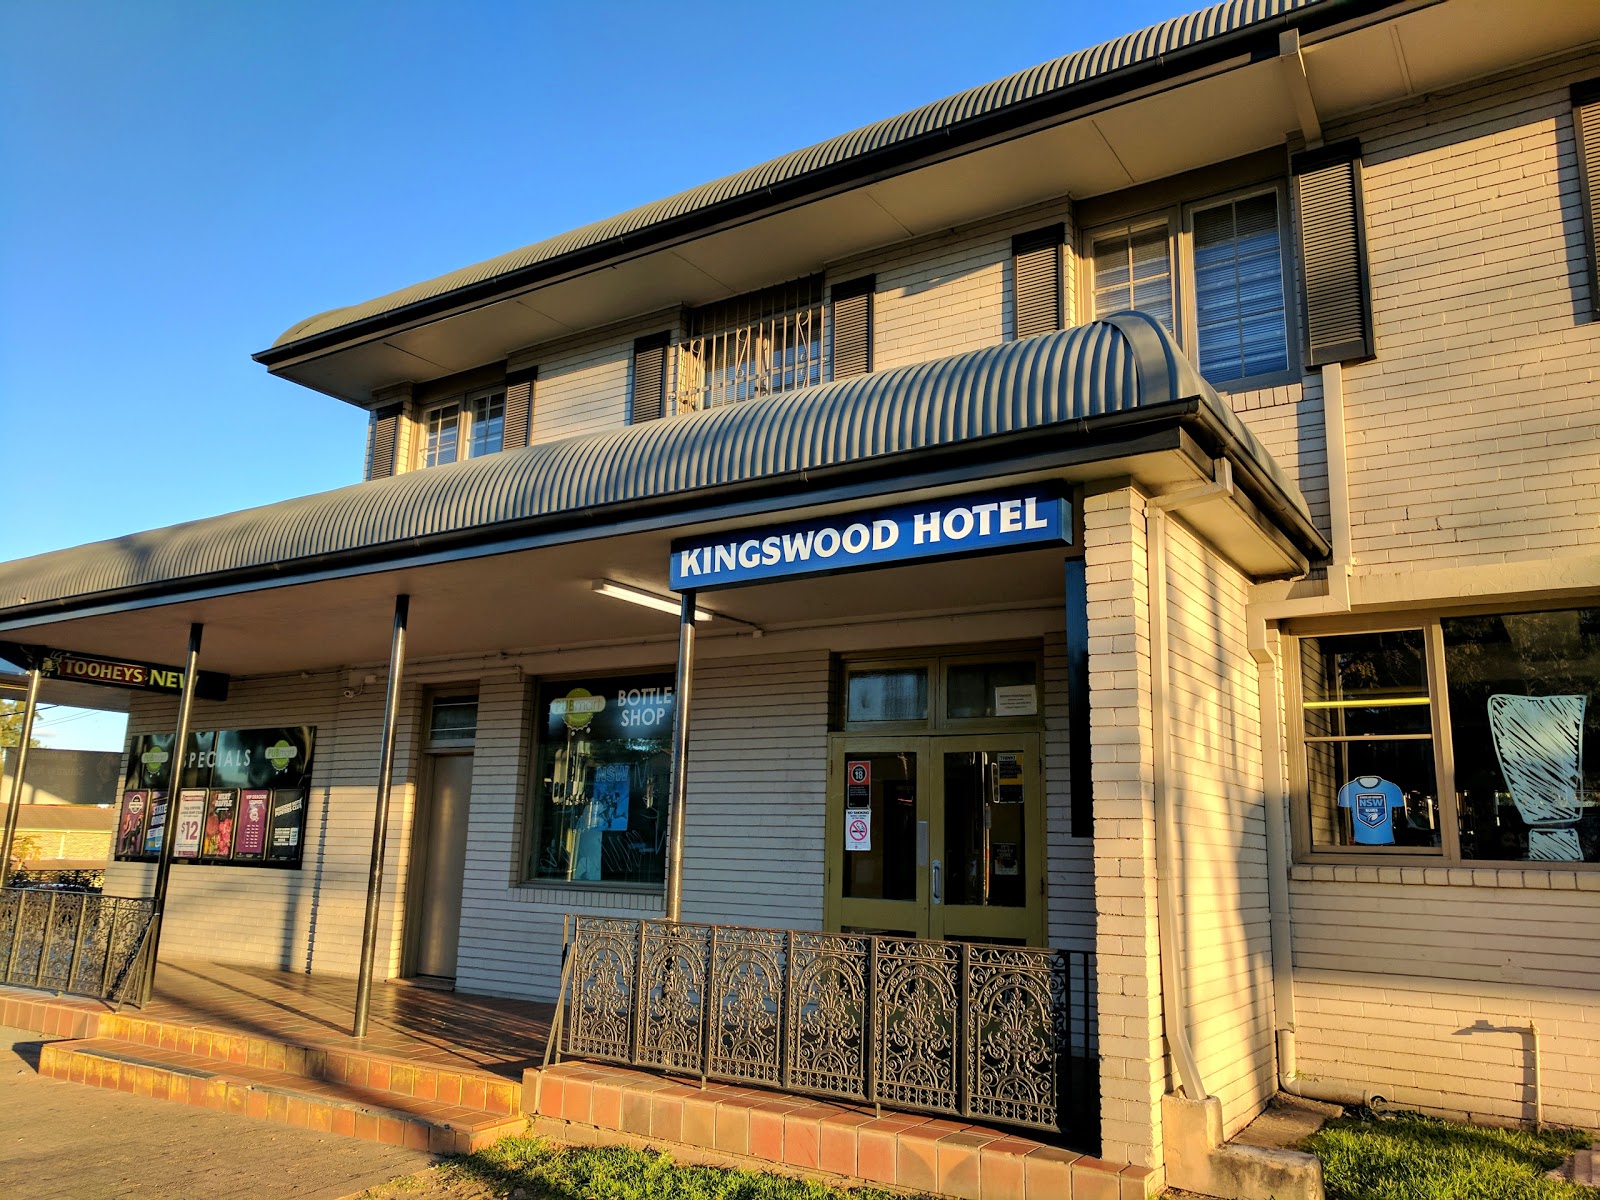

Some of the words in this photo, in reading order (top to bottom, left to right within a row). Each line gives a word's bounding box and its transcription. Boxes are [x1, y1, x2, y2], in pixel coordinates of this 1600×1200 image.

[680, 519, 899, 578] KINGSWOOD
[913, 497, 1047, 545] HOTEL
[64, 660, 143, 683] TOOHEYS
[555, 699, 602, 712] PUBmart
[618, 687, 672, 707] BOTTLE
[621, 708, 666, 727] SHOP
[596, 765, 629, 782] NSW
[854, 771, 863, 780] 18
[1359, 799, 1383, 807] NSW
[181, 821, 199, 840] $12
